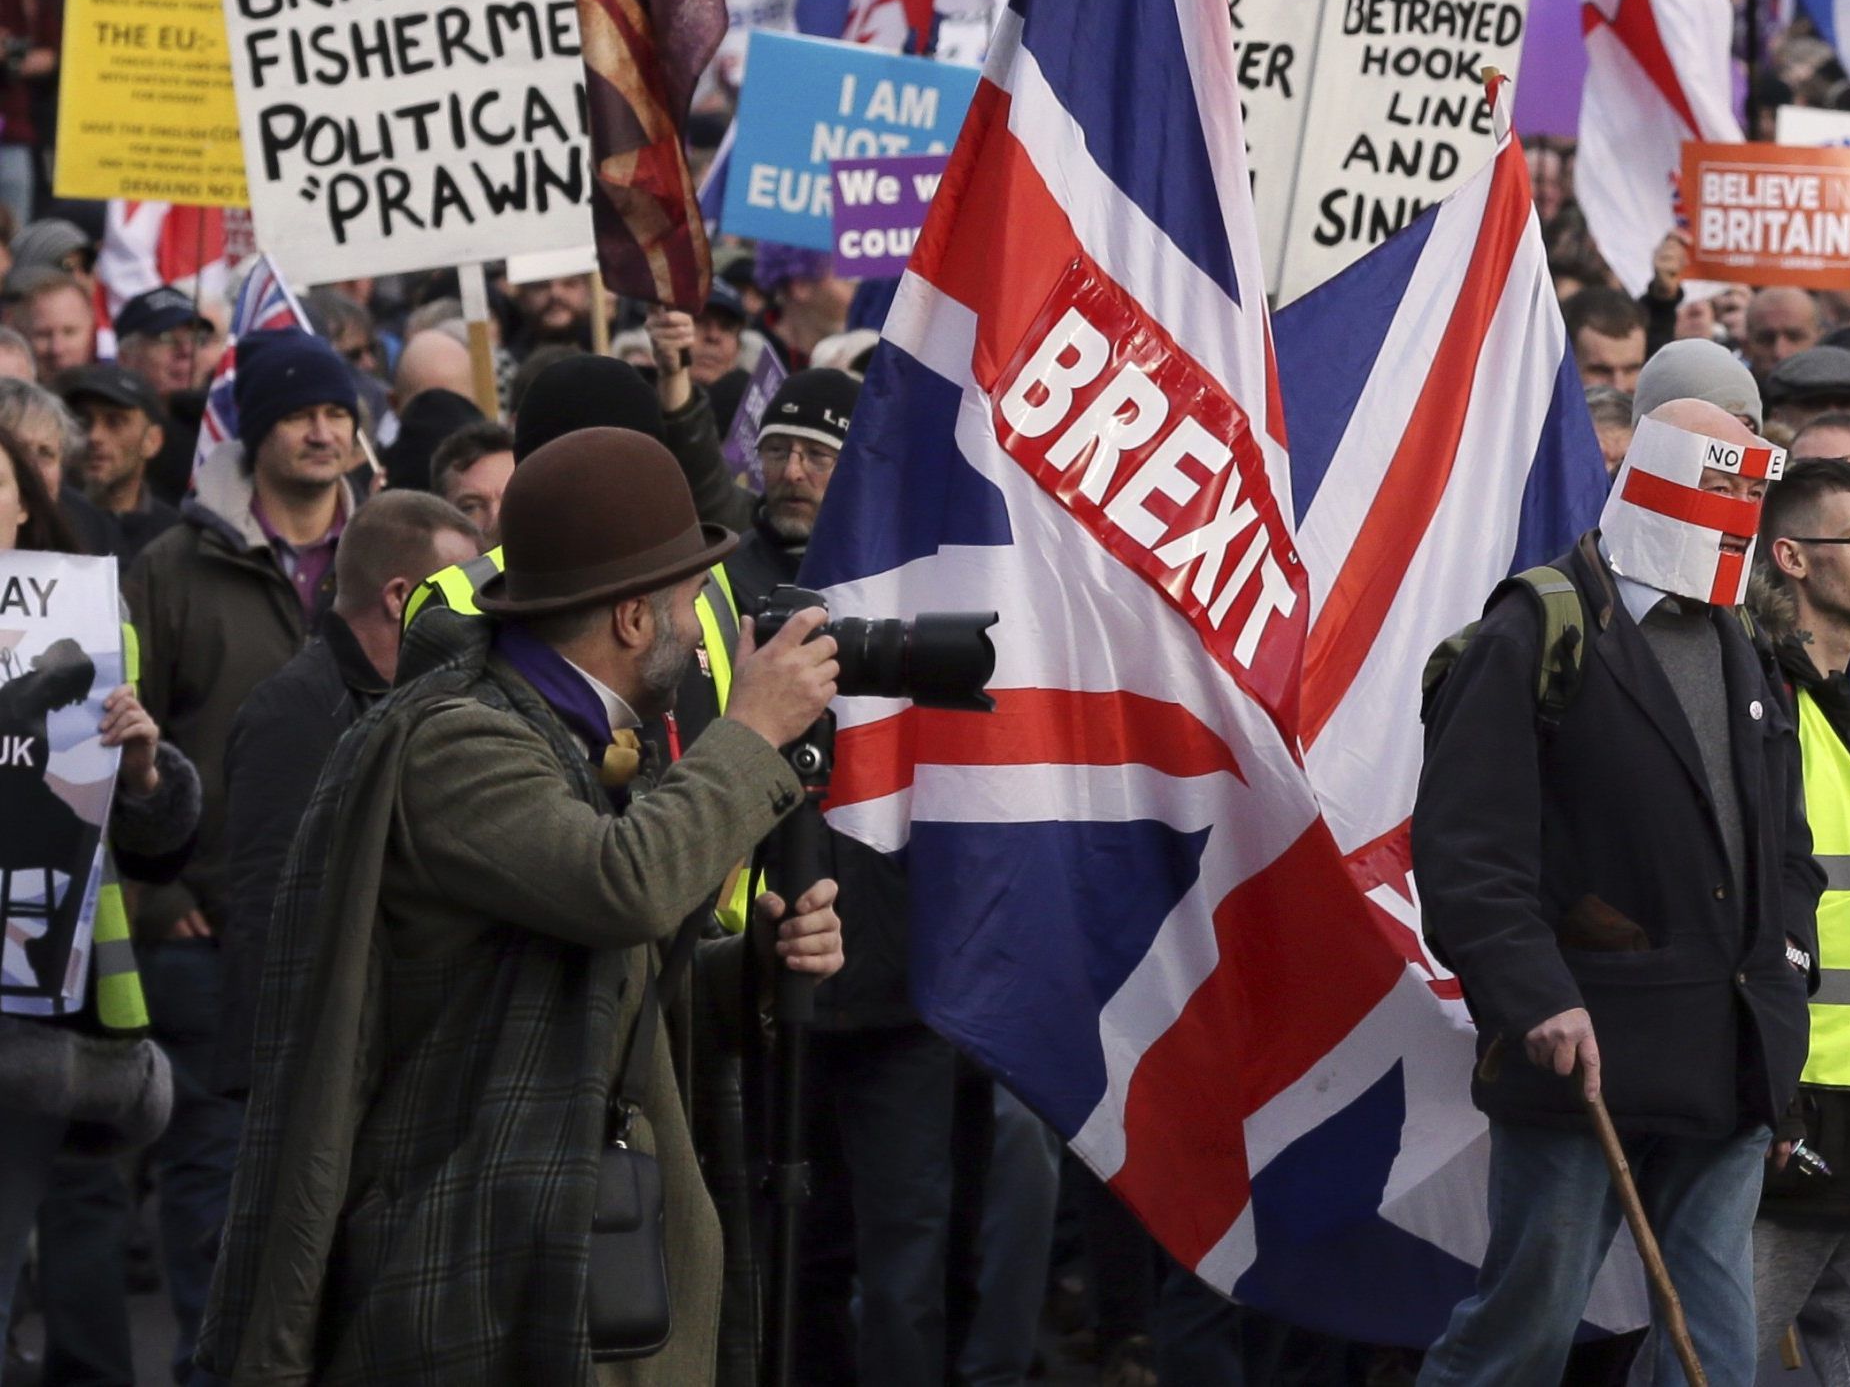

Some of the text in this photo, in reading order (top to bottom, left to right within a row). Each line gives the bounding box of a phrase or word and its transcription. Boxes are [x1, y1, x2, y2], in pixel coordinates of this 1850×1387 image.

[96, 21, 146, 47] THE
[245, 0, 581, 90] FISHERME
[1361, 45, 1486, 85] HOOK
[839, 74, 940, 130] I AM
[1387, 92, 1492, 135] LINE
[1342, 133, 1459, 181] AND
[837, 169, 899, 206] We
[1701, 171, 1821, 211] BELIEVE
[1708, 445, 1783, 475] NO E
[1000, 306, 1297, 670] BREXIT
